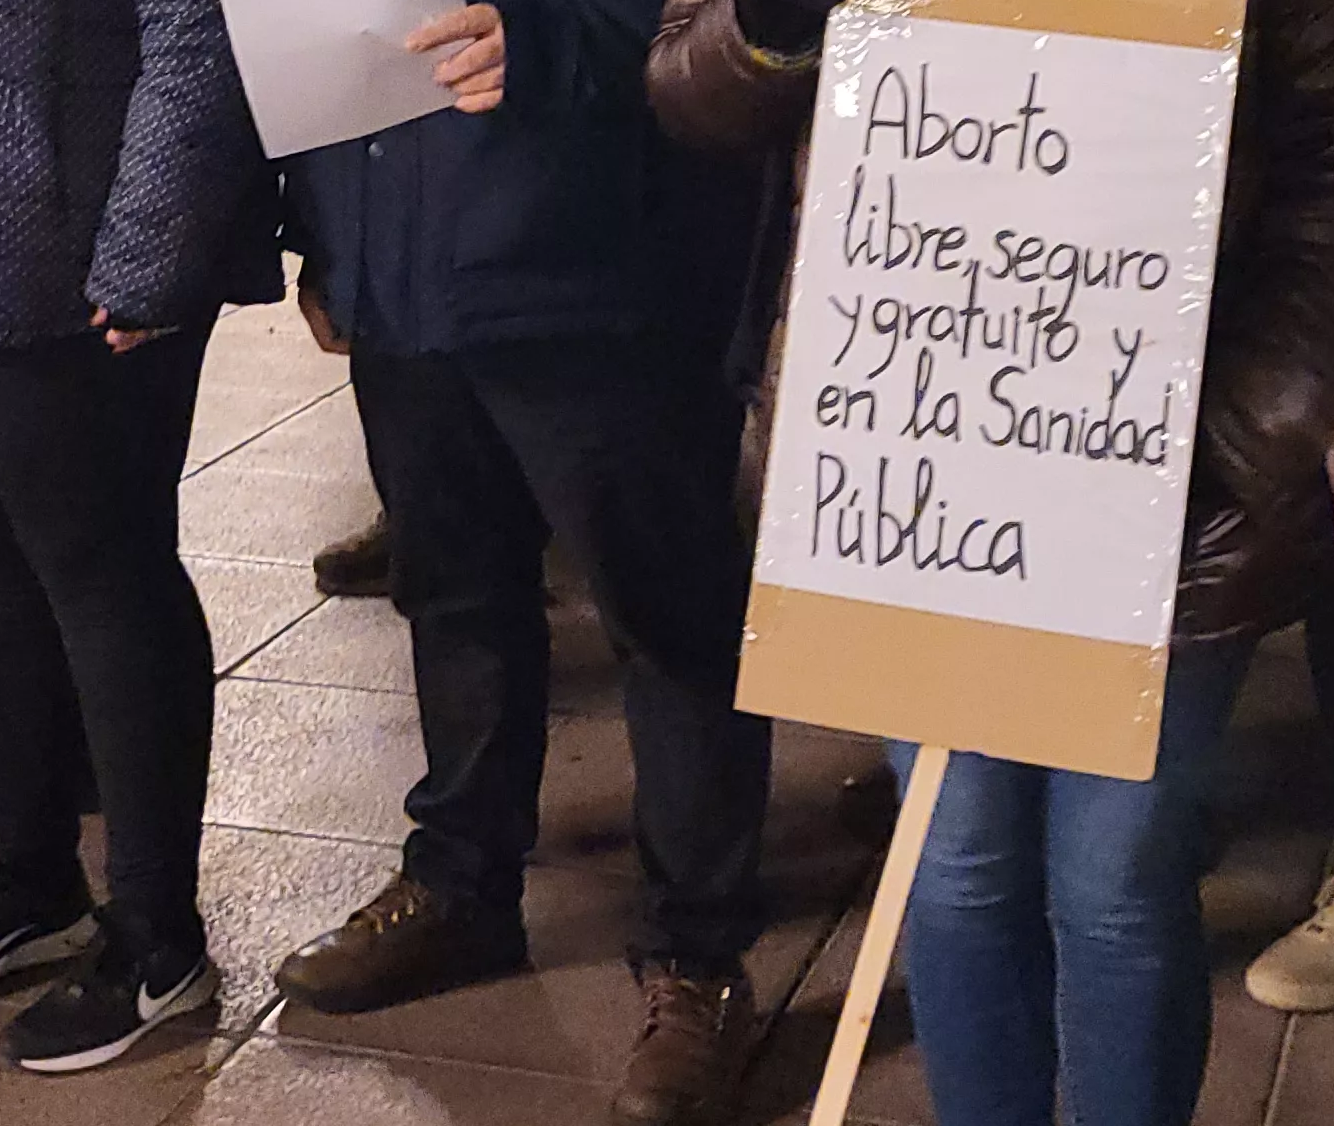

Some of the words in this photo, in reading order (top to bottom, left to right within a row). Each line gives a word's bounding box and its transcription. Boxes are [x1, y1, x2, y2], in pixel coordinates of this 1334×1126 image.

[864, 63, 1069, 175] Aborto
[985, 228, 1171, 324] seguro
[817, 384, 875, 431] en
[901, 347, 960, 443] la
[980, 365, 1172, 466] Sanidad
[1109, 327, 1143, 400] y
[811, 451, 1026, 580] Pública
